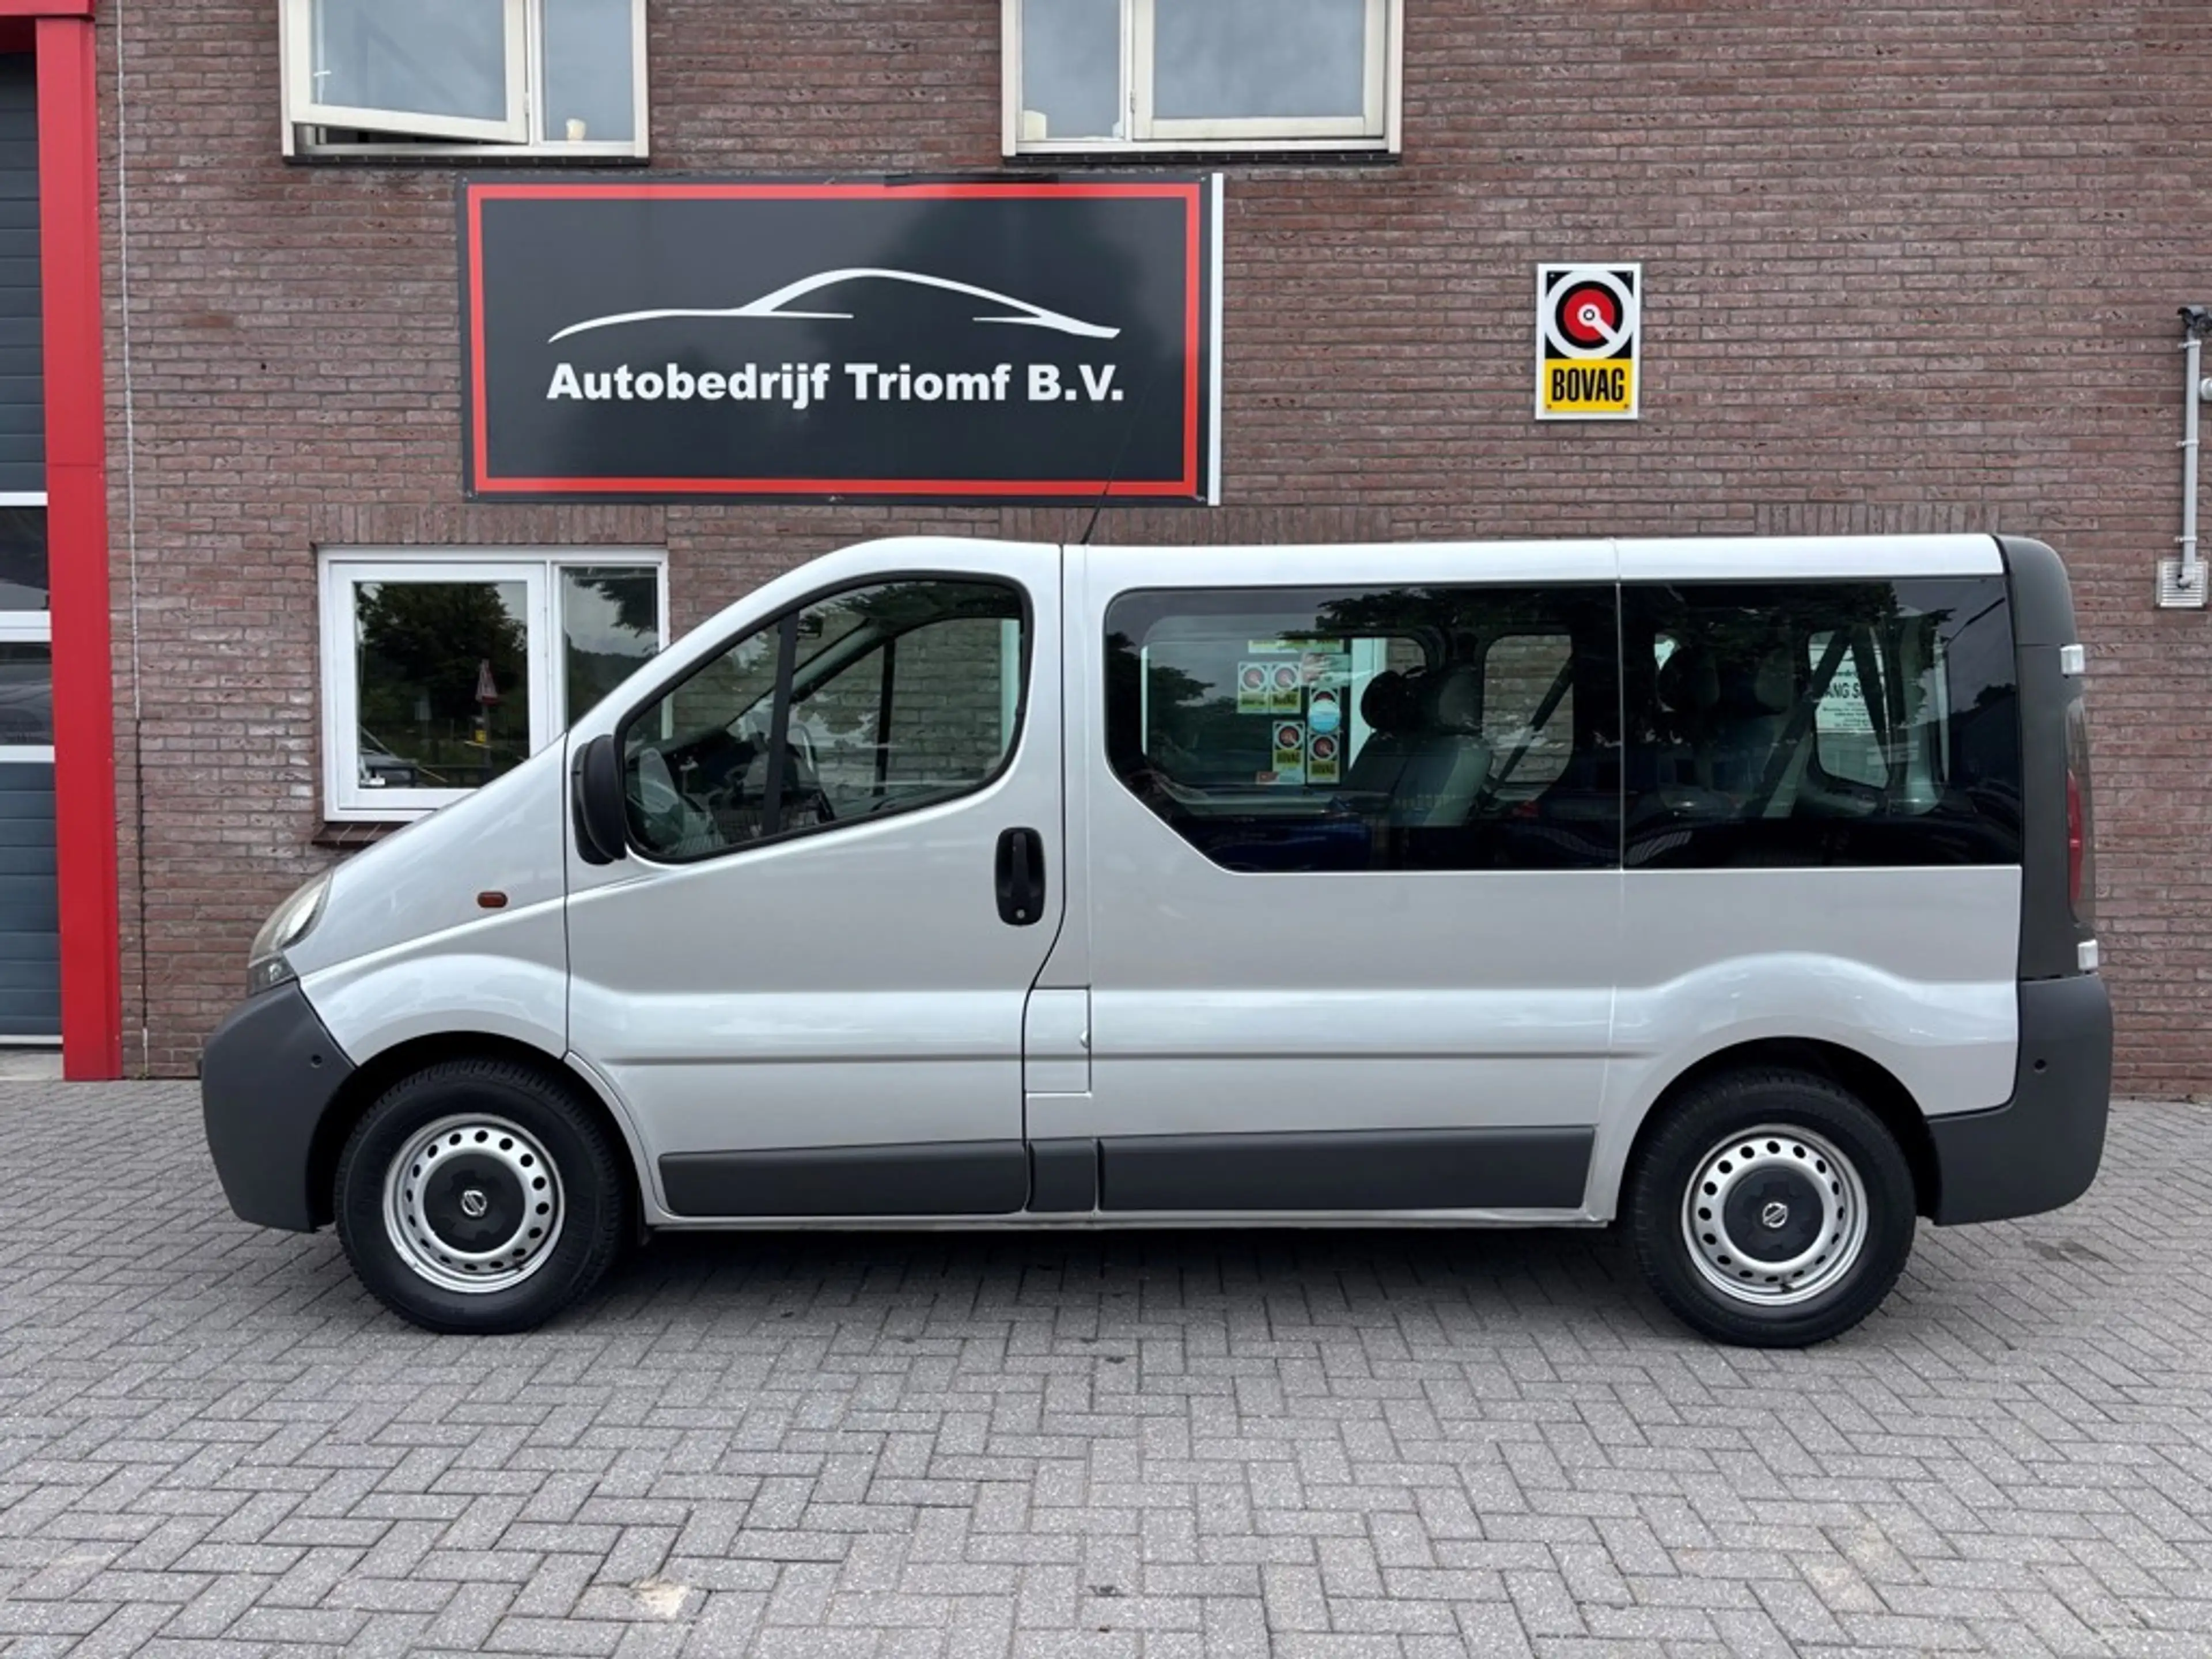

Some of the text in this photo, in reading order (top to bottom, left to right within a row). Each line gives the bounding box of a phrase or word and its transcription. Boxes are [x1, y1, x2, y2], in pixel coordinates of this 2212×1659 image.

[546, 362, 1124, 409] Autobedrijf Triomf B.V.
[1552, 367, 1625, 402] BOVAG
